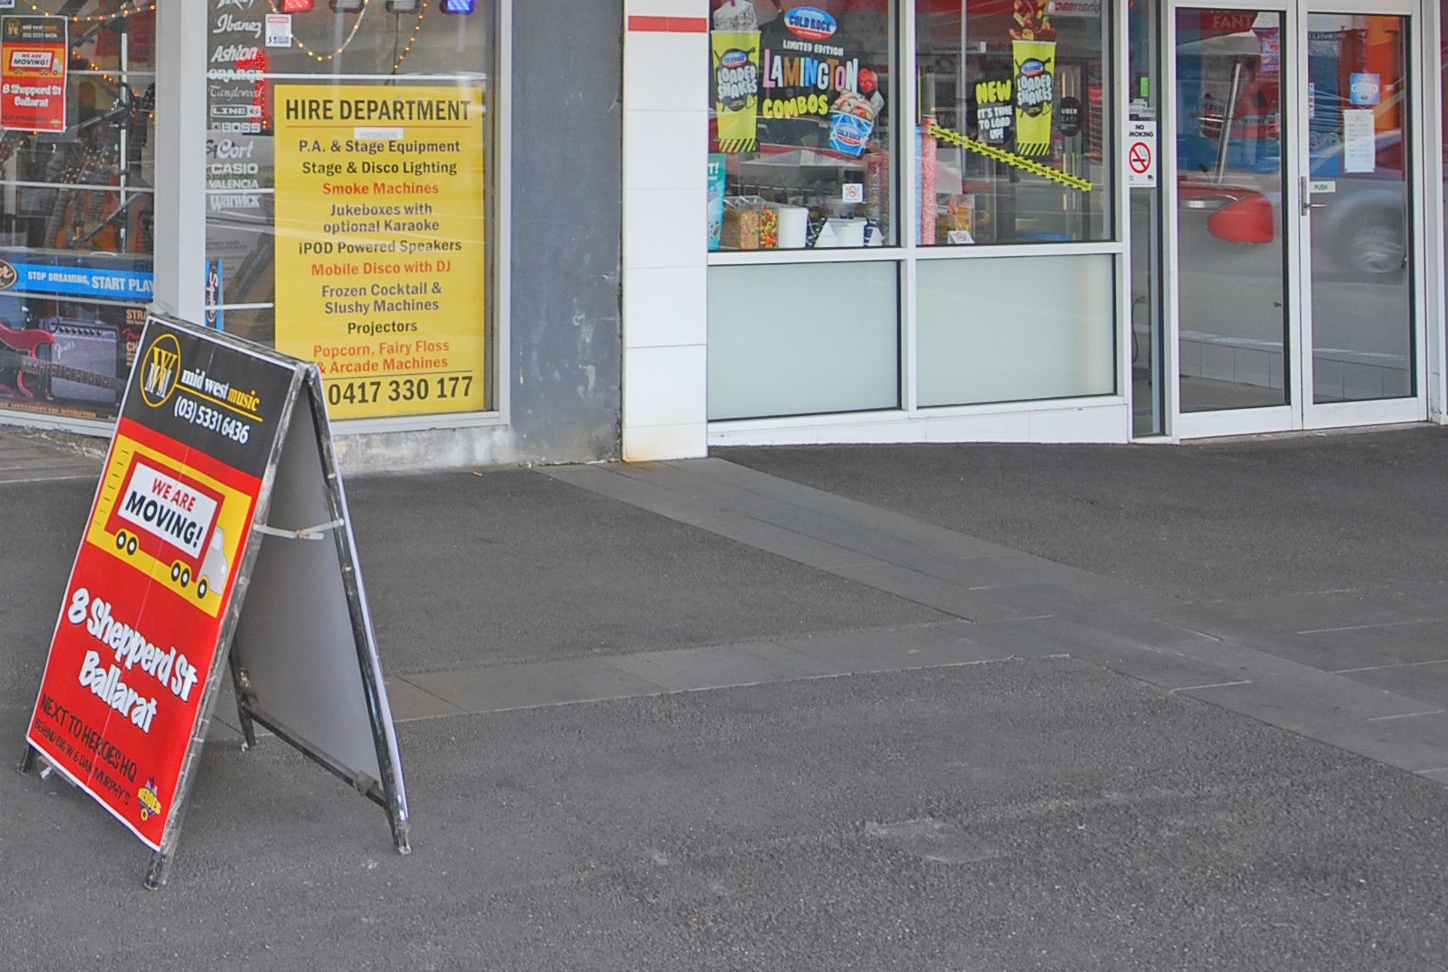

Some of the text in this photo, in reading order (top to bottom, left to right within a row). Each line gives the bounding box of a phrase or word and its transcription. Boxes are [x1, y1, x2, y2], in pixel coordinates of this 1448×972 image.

[213, 14, 262, 38] Ibanez
[789, 14, 832, 32] COLD ROCK
[211, 45, 258, 63] Ashton
[783, 39, 844, 56] LIMITED EDITION
[14, 58, 49, 66] MOVING!
[718, 65, 757, 84] LOADED
[762, 49, 859, 94] LAMINGTON
[717, 78, 758, 100] SHAKES
[976, 79, 1013, 104] NEW
[1017, 75, 1052, 93] LOADED
[762, 93, 829, 119] COMBOS
[1017, 88, 1053, 106] SHAKES
[213, 107, 246, 115] LINE
[286, 99, 470, 121] HIRE DEPARTMENT
[977, 105, 1013, 119] IT'S TIME
[222, 122, 260, 133] BOSS
[979, 117, 1011, 130] TO LOAD
[989, 128, 1004, 140] UP!
[217, 139, 253, 159] Cort
[299, 140, 460, 155] P.A. & Stage Equipment
[211, 163, 258, 175] CASIO
[302, 161, 457, 176] Stage & Disco Lighting
[209, 180, 259, 189] VALENCIA
[323, 182, 439, 195] Smoke Machines
[330, 203, 433, 217] Jukeboxes with
[323, 219, 440, 235] optional Karaoke
[299, 240, 462, 254] iPOD Powered Speakers
[311, 260, 452, 276] Mobile Disco with DJ
[28, 271, 47, 281] STOP
[92, 276, 125, 291] START
[322, 282, 442, 298] Frozen Cocktail &
[324, 299, 439, 315] Slushy Machines
[347, 321, 417, 336] Projectors
[313, 340, 450, 359] Popcorn, Fairy Floss
[316, 357, 448, 374] & Arcade Machines
[181, 368, 260, 411] mid west music
[328, 376, 473, 406] 0417 330 177
[174, 396, 250, 444] (03) 5331 6436
[151, 477, 197, 513] WE ARE
[124, 491, 202, 551] MOVING!
[67, 587, 199, 704] 8 Shepperd St
[78, 650, 158, 734] Ballarat
[40, 694, 138, 784] NEXT TO HEROES HQ
